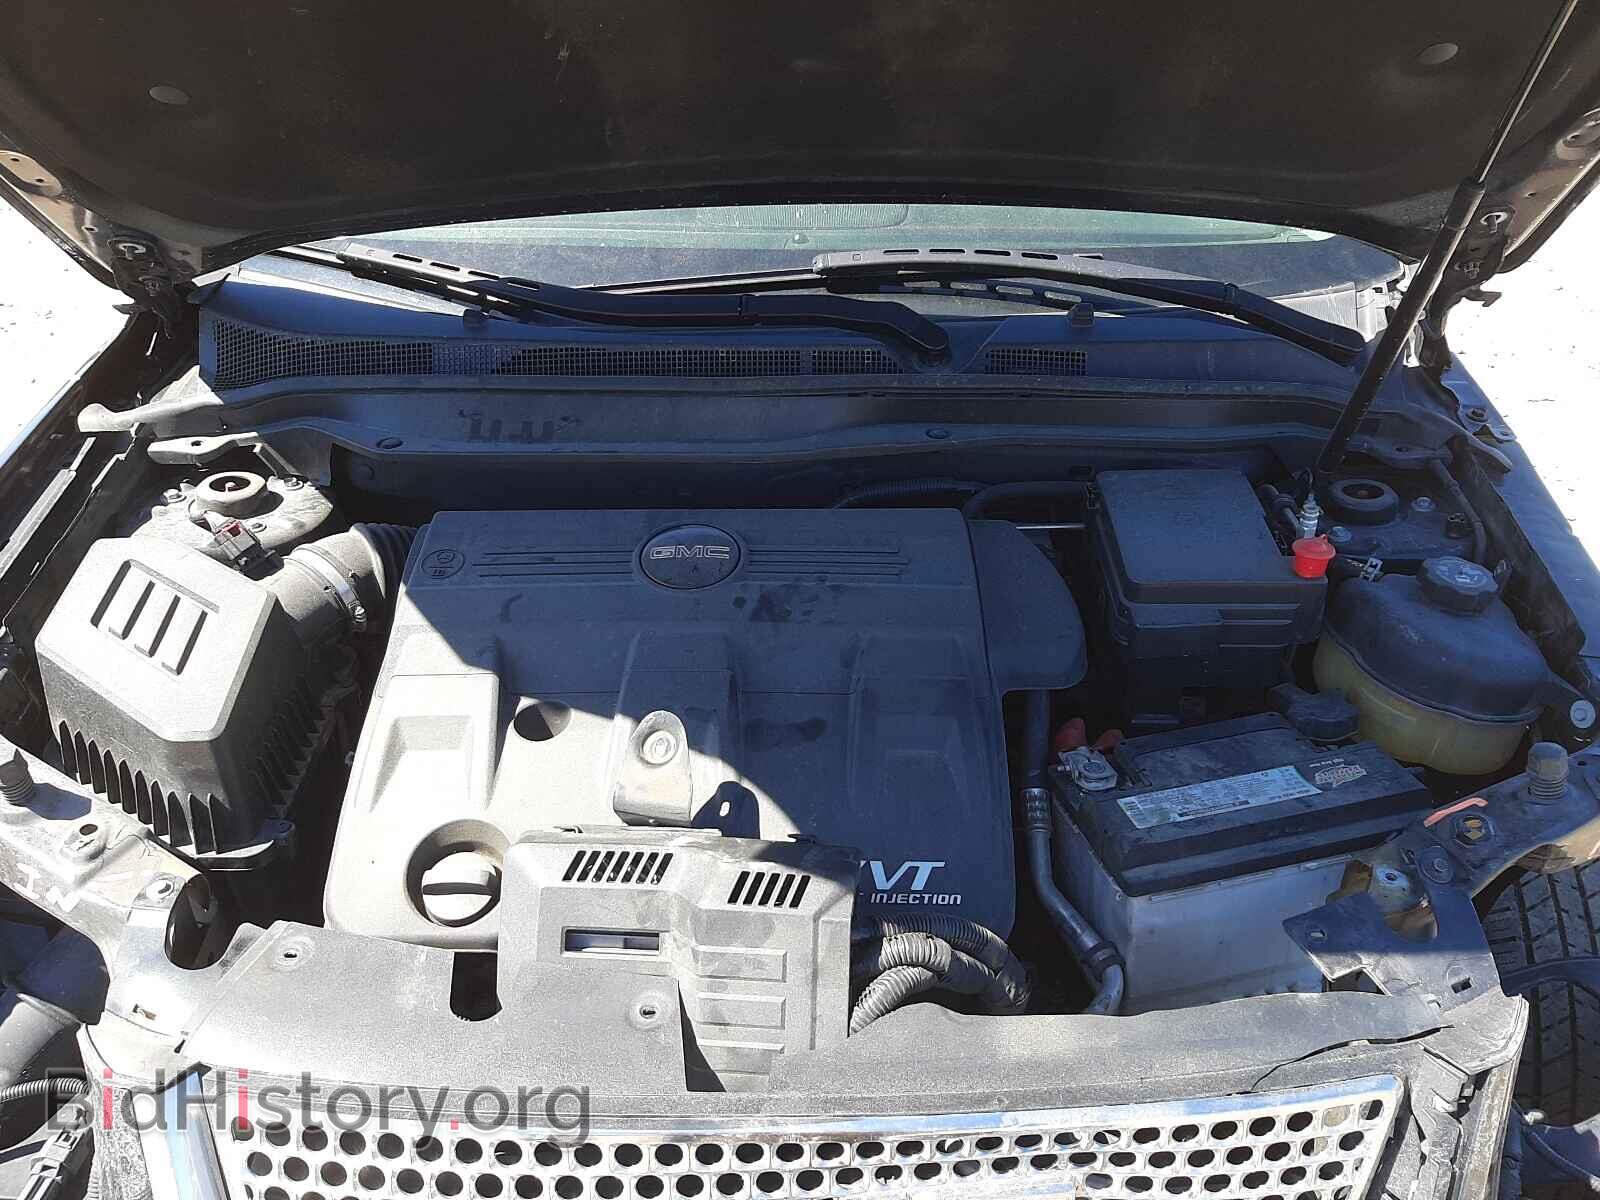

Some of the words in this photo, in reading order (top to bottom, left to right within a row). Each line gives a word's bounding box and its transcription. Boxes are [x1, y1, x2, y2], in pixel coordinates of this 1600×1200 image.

[650, 545, 730, 560] GMC
[860, 860, 945, 891] VT
[870, 893, 962, 905] INJECTION
